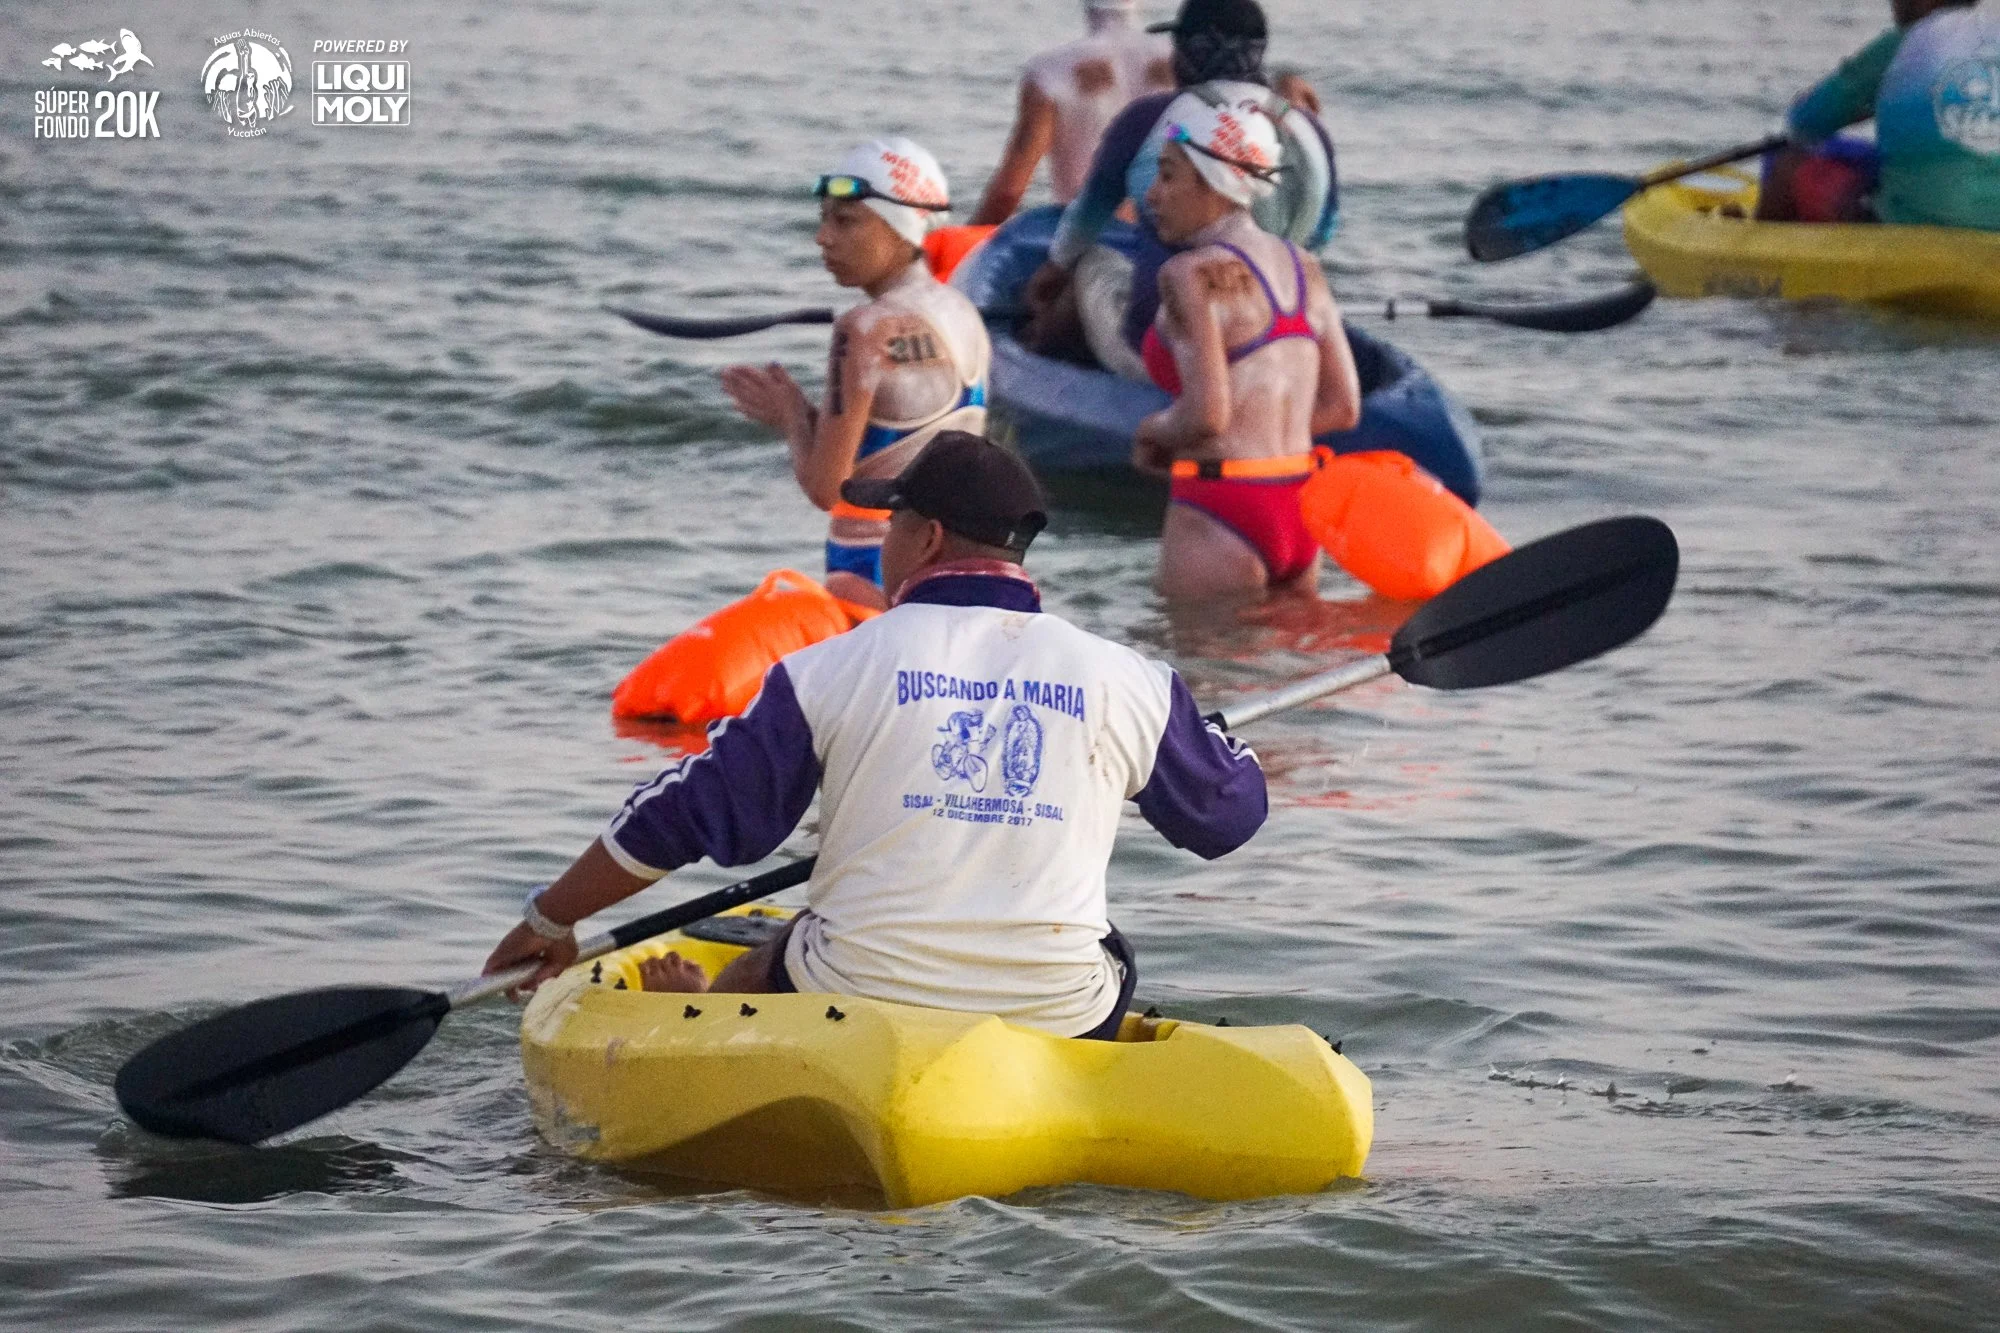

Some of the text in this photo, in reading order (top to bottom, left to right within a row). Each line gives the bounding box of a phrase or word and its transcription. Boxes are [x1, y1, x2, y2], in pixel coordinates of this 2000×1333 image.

[897, 670, 1085, 722] BUSCANDO A MARIA
[902, 794, 933, 809] SISAL
[944, 793, 1024, 815] VILLAHERMOSA
[1034, 803, 1064, 821] SISAL
[932, 808, 1033, 827] 12 DICIEMBRE 2017
